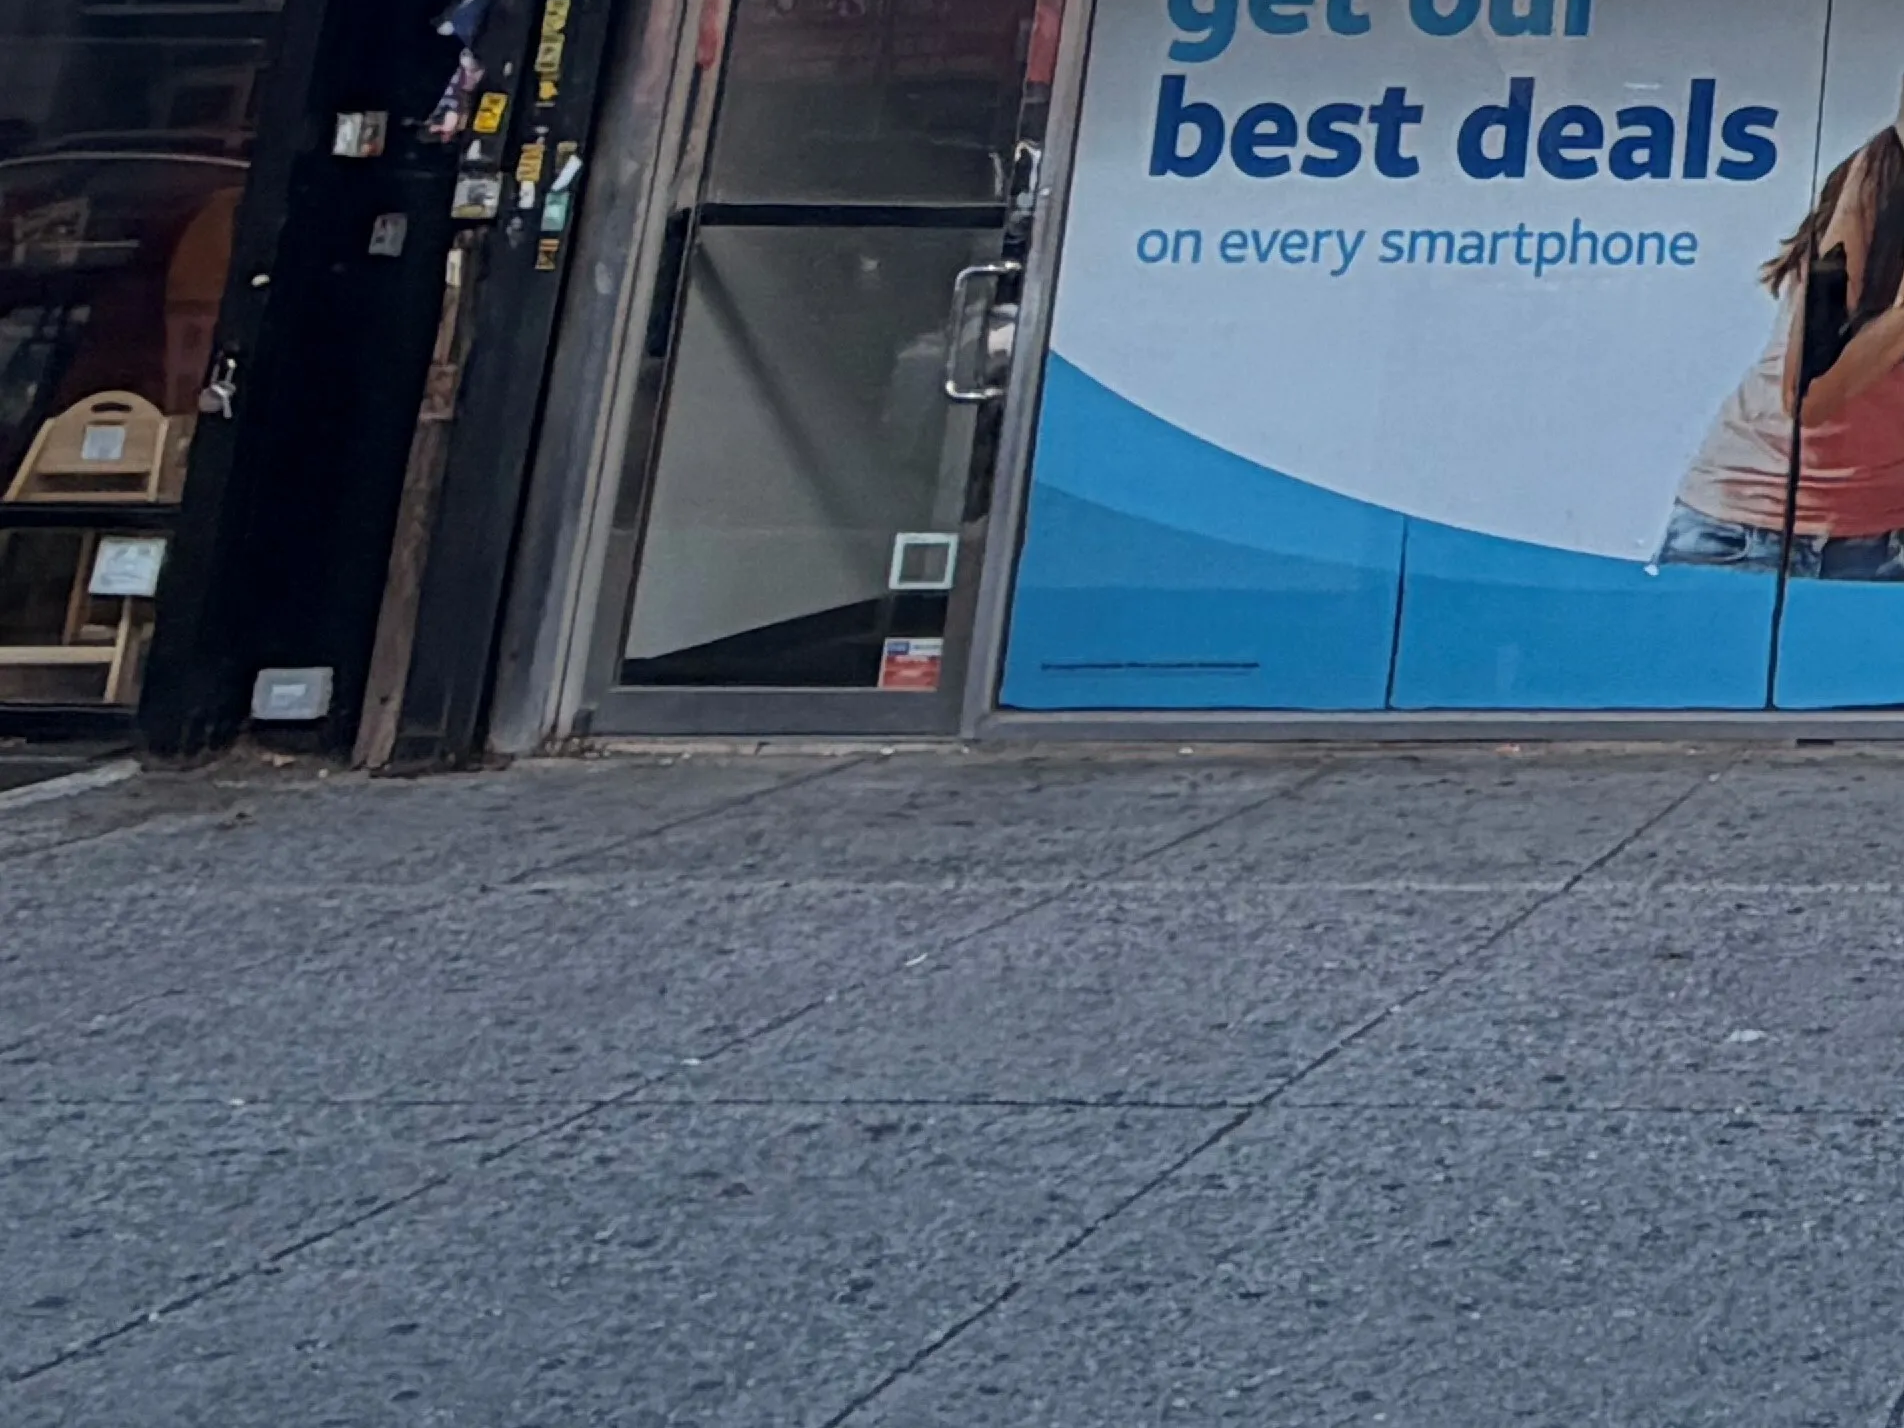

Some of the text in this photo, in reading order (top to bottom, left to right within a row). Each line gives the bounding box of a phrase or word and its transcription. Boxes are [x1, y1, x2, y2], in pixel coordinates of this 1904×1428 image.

[1149, 74, 1779, 180] best deals
[1137, 218, 1698, 278] on every smartphone
